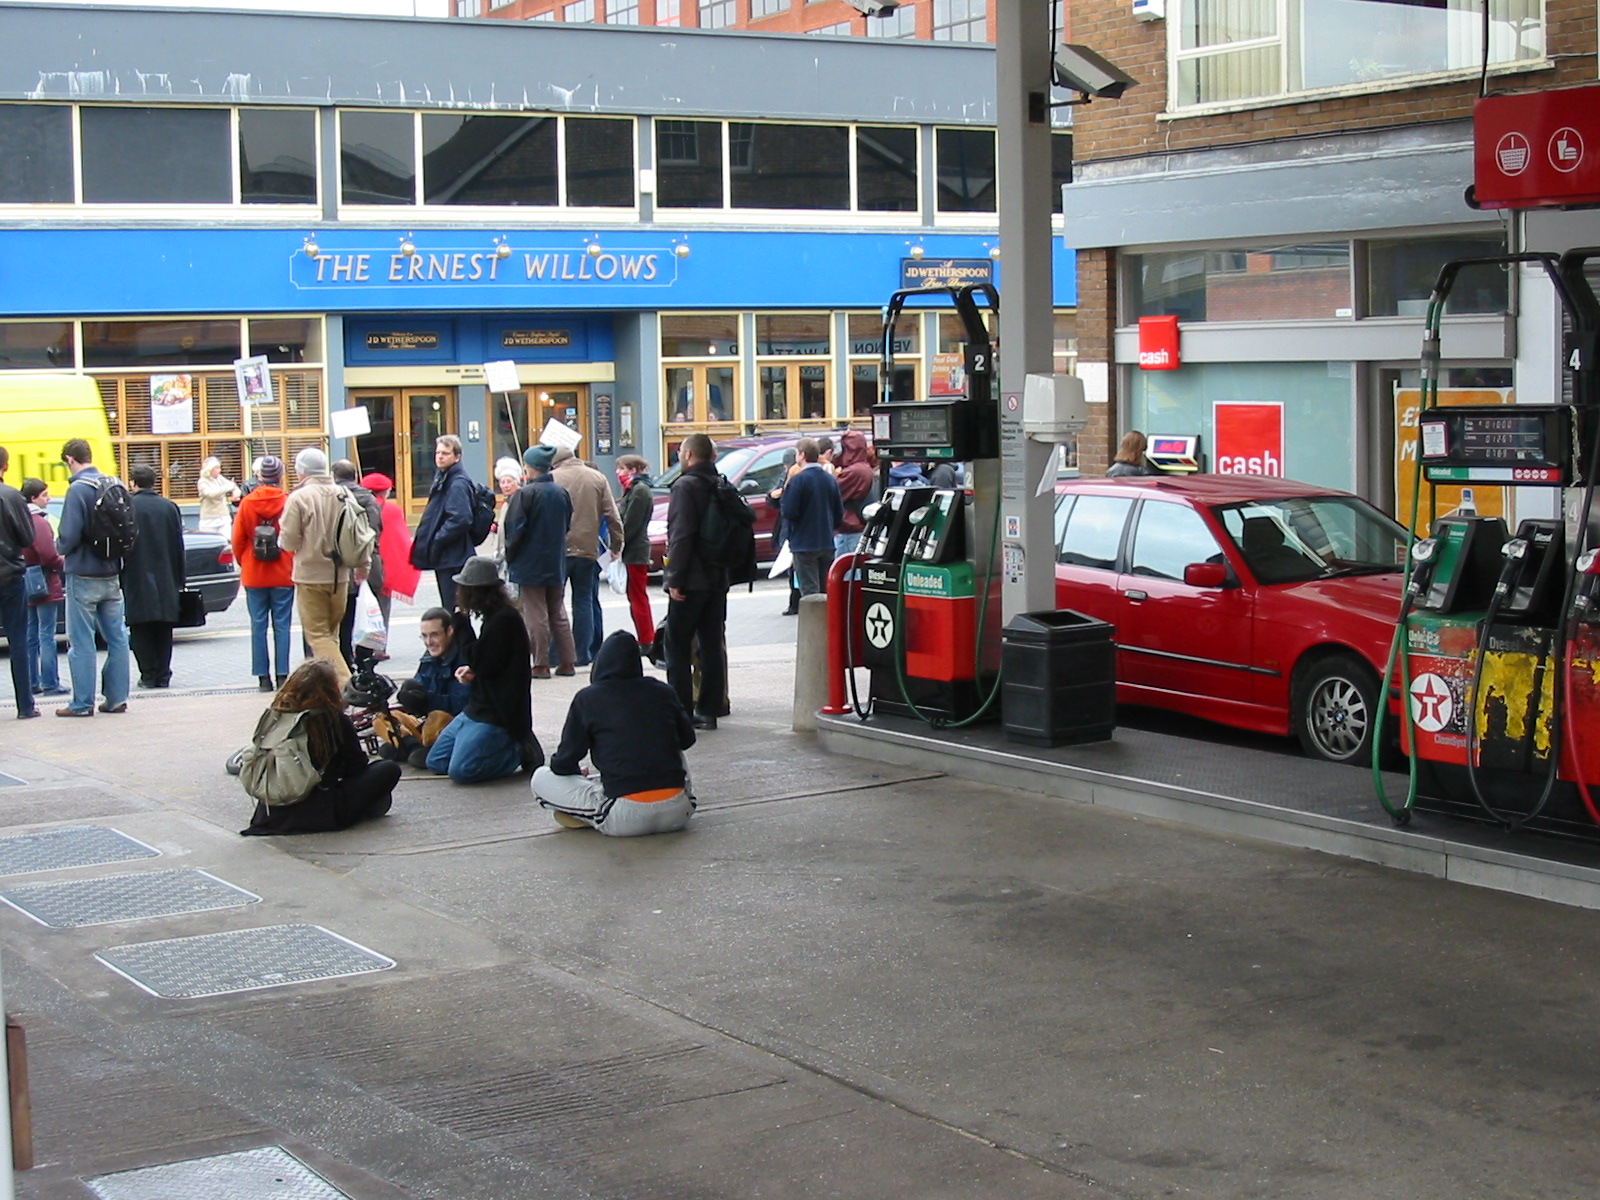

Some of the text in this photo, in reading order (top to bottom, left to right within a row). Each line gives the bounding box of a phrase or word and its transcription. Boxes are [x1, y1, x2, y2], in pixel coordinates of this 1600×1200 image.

[314, 253, 658, 282] THE ERNEST WILLOWS
[920, 268, 988, 277] WETHERSPOON
[974, 354, 985, 371] 2
[1140, 348, 1169, 364] cash
[1569, 348, 1581, 370] 4
[1219, 450, 1278, 477] cash
[907, 572, 943, 589] Unleaded
